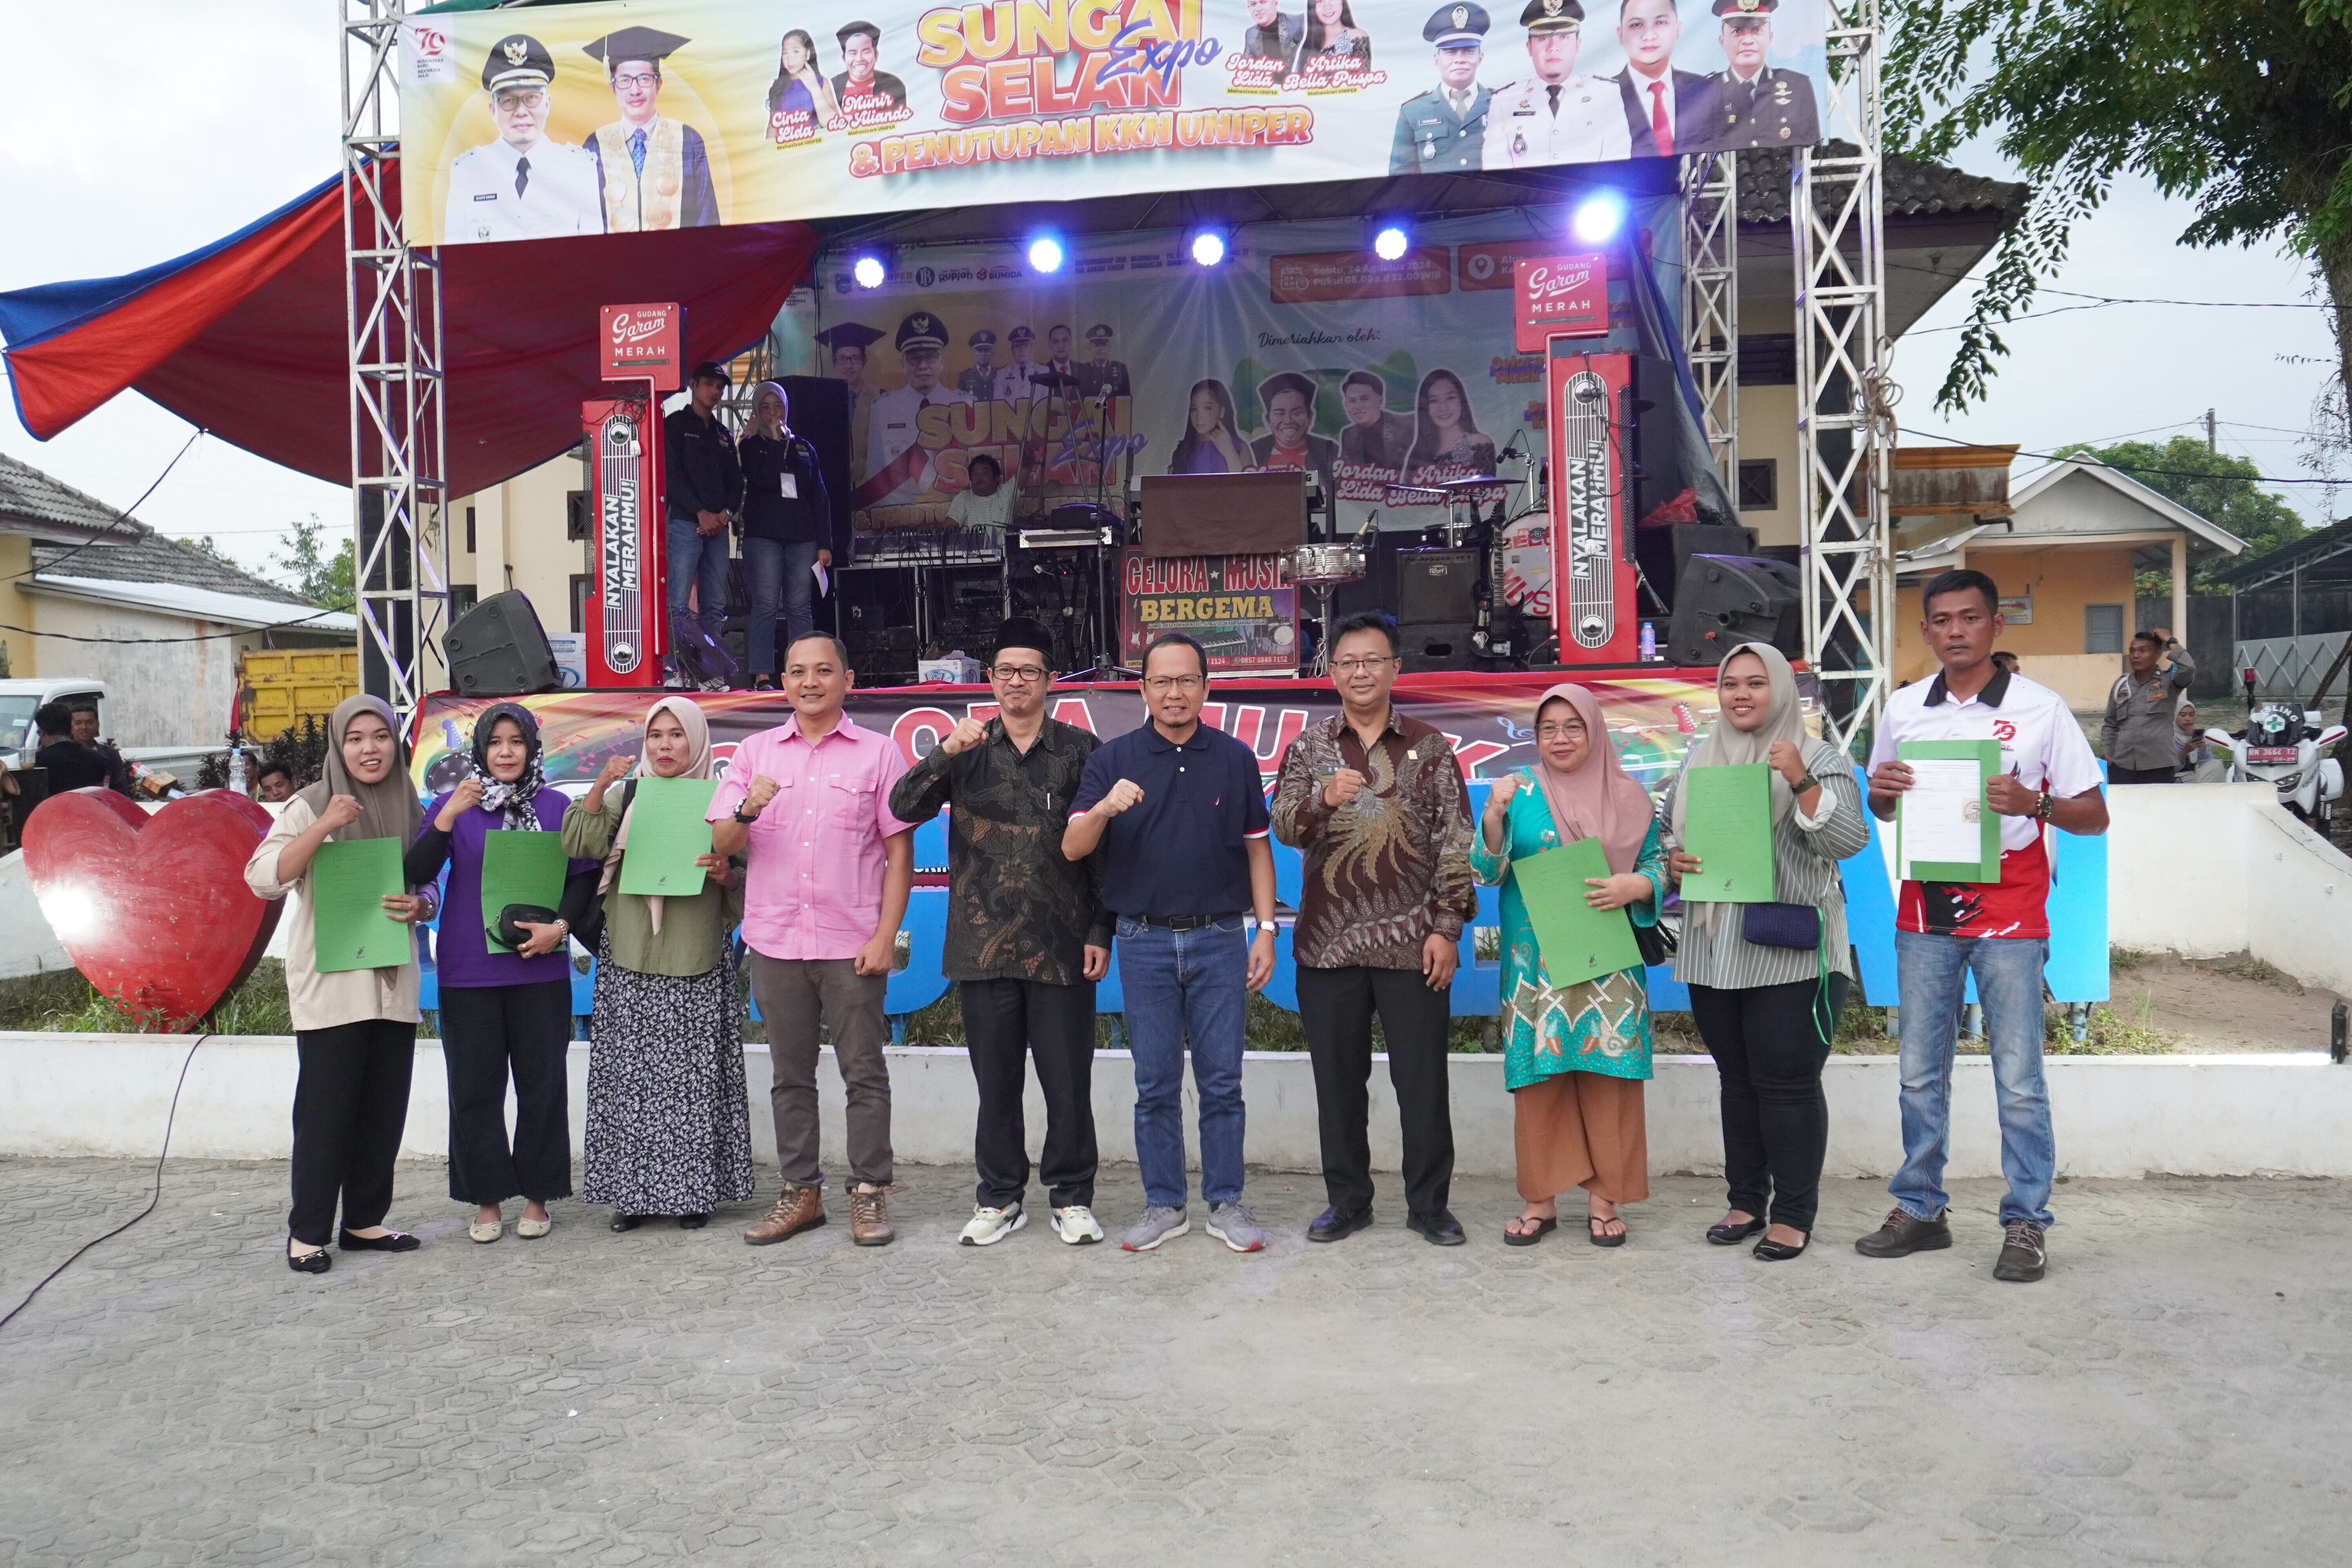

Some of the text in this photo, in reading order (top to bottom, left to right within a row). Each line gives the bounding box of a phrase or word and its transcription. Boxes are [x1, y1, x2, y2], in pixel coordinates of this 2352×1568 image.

[415, 27, 445, 56] 79
[918, 0, 1201, 66] SUNGAI
[1097, 18, 1223, 94] Expo
[1227, 54, 1286, 71] Jordan
[1306, 54, 1363, 73] Artika
[942, 51, 1181, 123] SELAN
[1233, 71, 1274, 86] Lida
[1283, 71, 1386, 89] Bella Puspa
[844, 93, 894, 113] Munir
[771, 110, 811, 128] Cinta
[828, 105, 912, 130] de Aliando
[776, 125, 814, 142] Lida
[848, 127, 877, 136] Mahasiswa
[850, 106, 1312, 176] & PENUTUPAN KKN UNIPER
[777, 141, 804, 150] Mahasiswi
[1406, 260, 1431, 270] 2024
[1558, 262, 1592, 271] GUDANG
[1314, 276, 1343, 285] Pukul
[1421, 270, 1441, 280] WIB
[1529, 267, 1590, 299] Garam
[1533, 299, 1591, 312] MERAH
[612, 313, 665, 344] Garam
[1258, 328, 1381, 348] Dimeriahkan oleh:
[615, 346, 665, 357] MERAH
[916, 395, 1132, 449] SUNGAI
[1332, 460, 1398, 482] Jordan
[1338, 479, 1384, 500] Lida
[1588, 443, 1607, 557] MERAHMU!
[1571, 459, 1589, 577] NYALAKAN
[621, 481, 636, 588] MERAHMU!
[605, 496, 620, 607] NYALAKAN
[1223, 554, 1294, 592] MUSI
[1140, 595, 1274, 622] BERGEMA
[1993, 720, 2016, 741] 79
